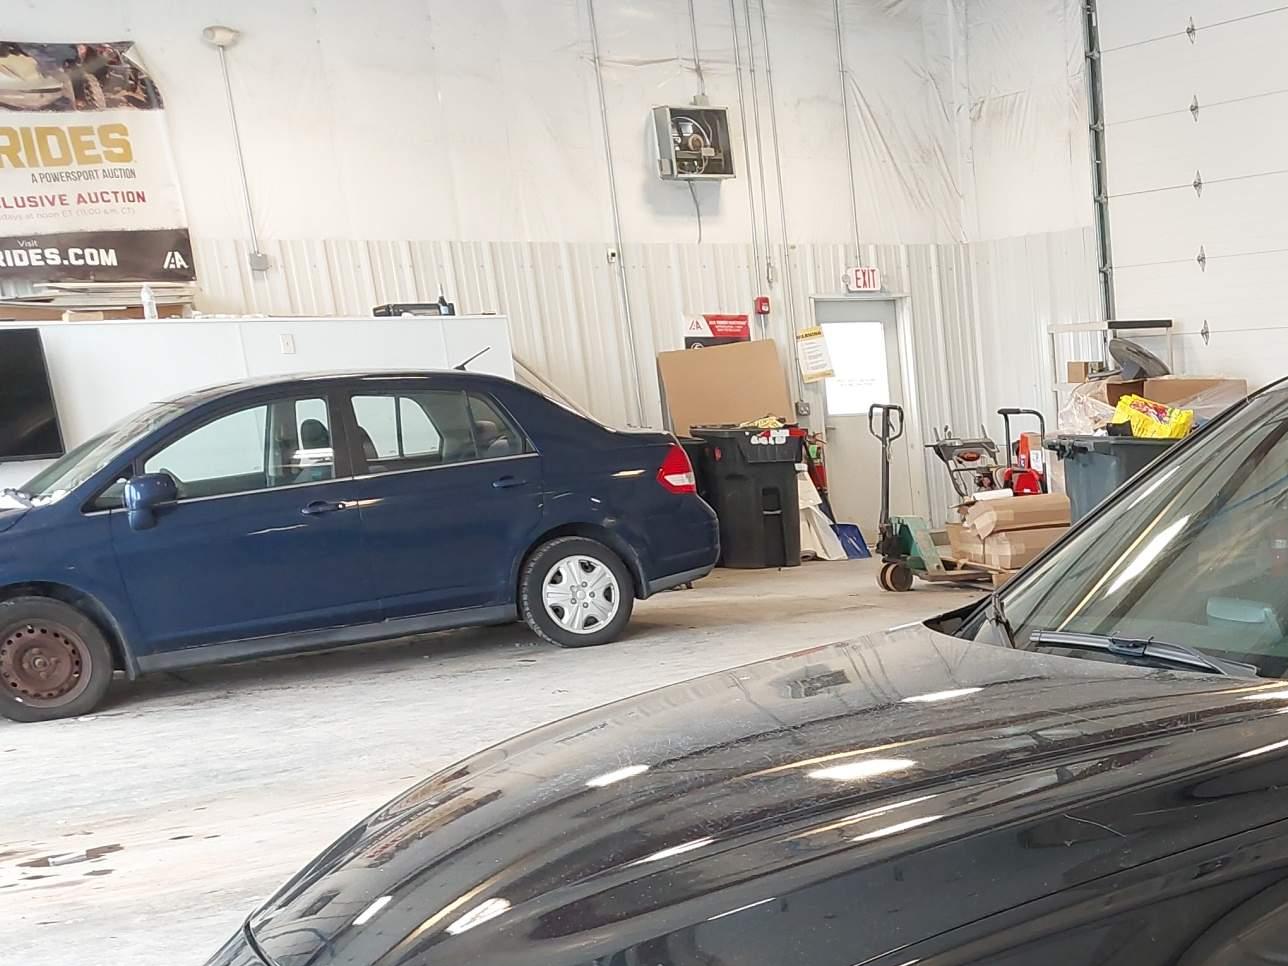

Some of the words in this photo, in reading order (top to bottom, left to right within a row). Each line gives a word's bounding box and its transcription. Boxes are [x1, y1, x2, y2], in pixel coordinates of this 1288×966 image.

[40, 169, 99, 183] POWERSPORT
[102, 168, 136, 179] AUCTION
[0, 194, 70, 208] LUSIVE
[76, 191, 146, 204] AUCTION
[855, 269, 875, 288] EXIT
